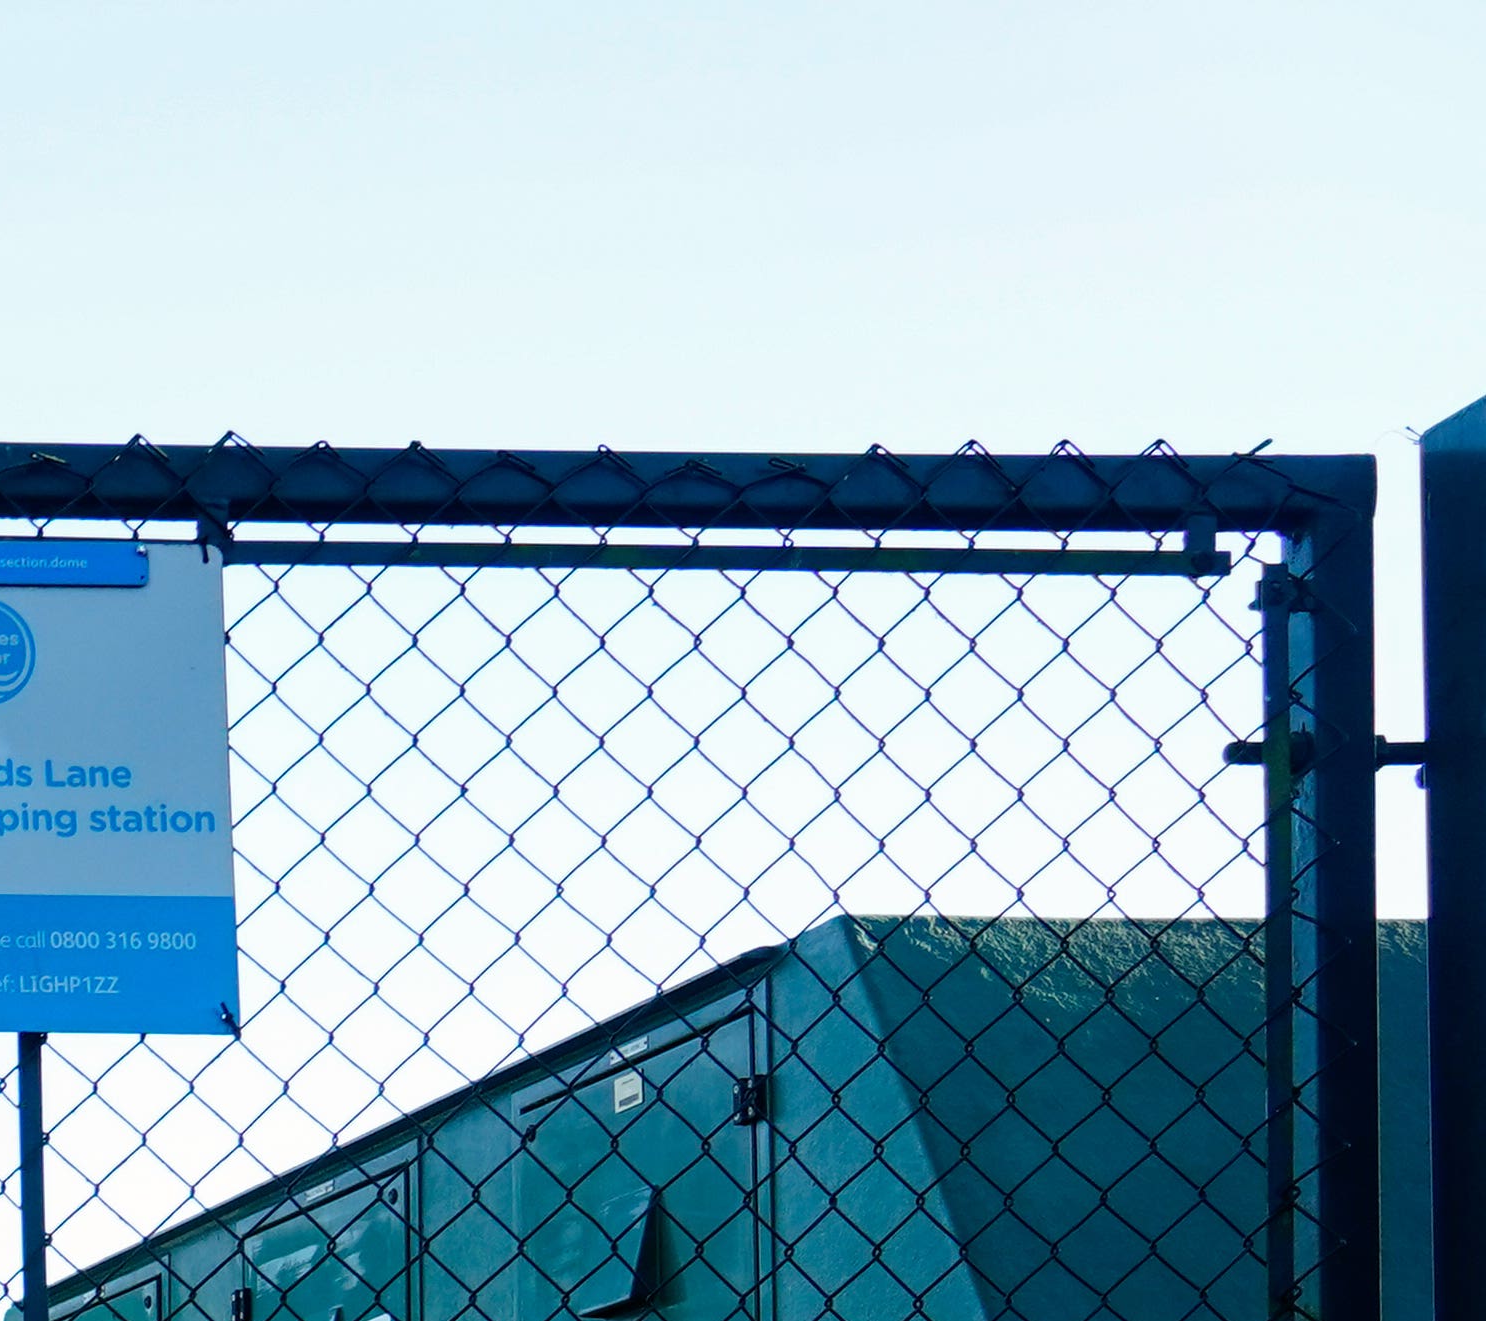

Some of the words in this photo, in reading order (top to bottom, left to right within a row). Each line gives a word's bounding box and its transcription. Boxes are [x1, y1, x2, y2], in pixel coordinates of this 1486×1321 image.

[45, 759, 132, 788] Lane
[89, 803, 216, 833] station
[15, 931, 46, 949] call
[50, 931, 100, 949] 0800
[106, 932, 142, 950] 316
[147, 932, 196, 950] 9800
[20, 976, 119, 994] LIGHP1ZZ
